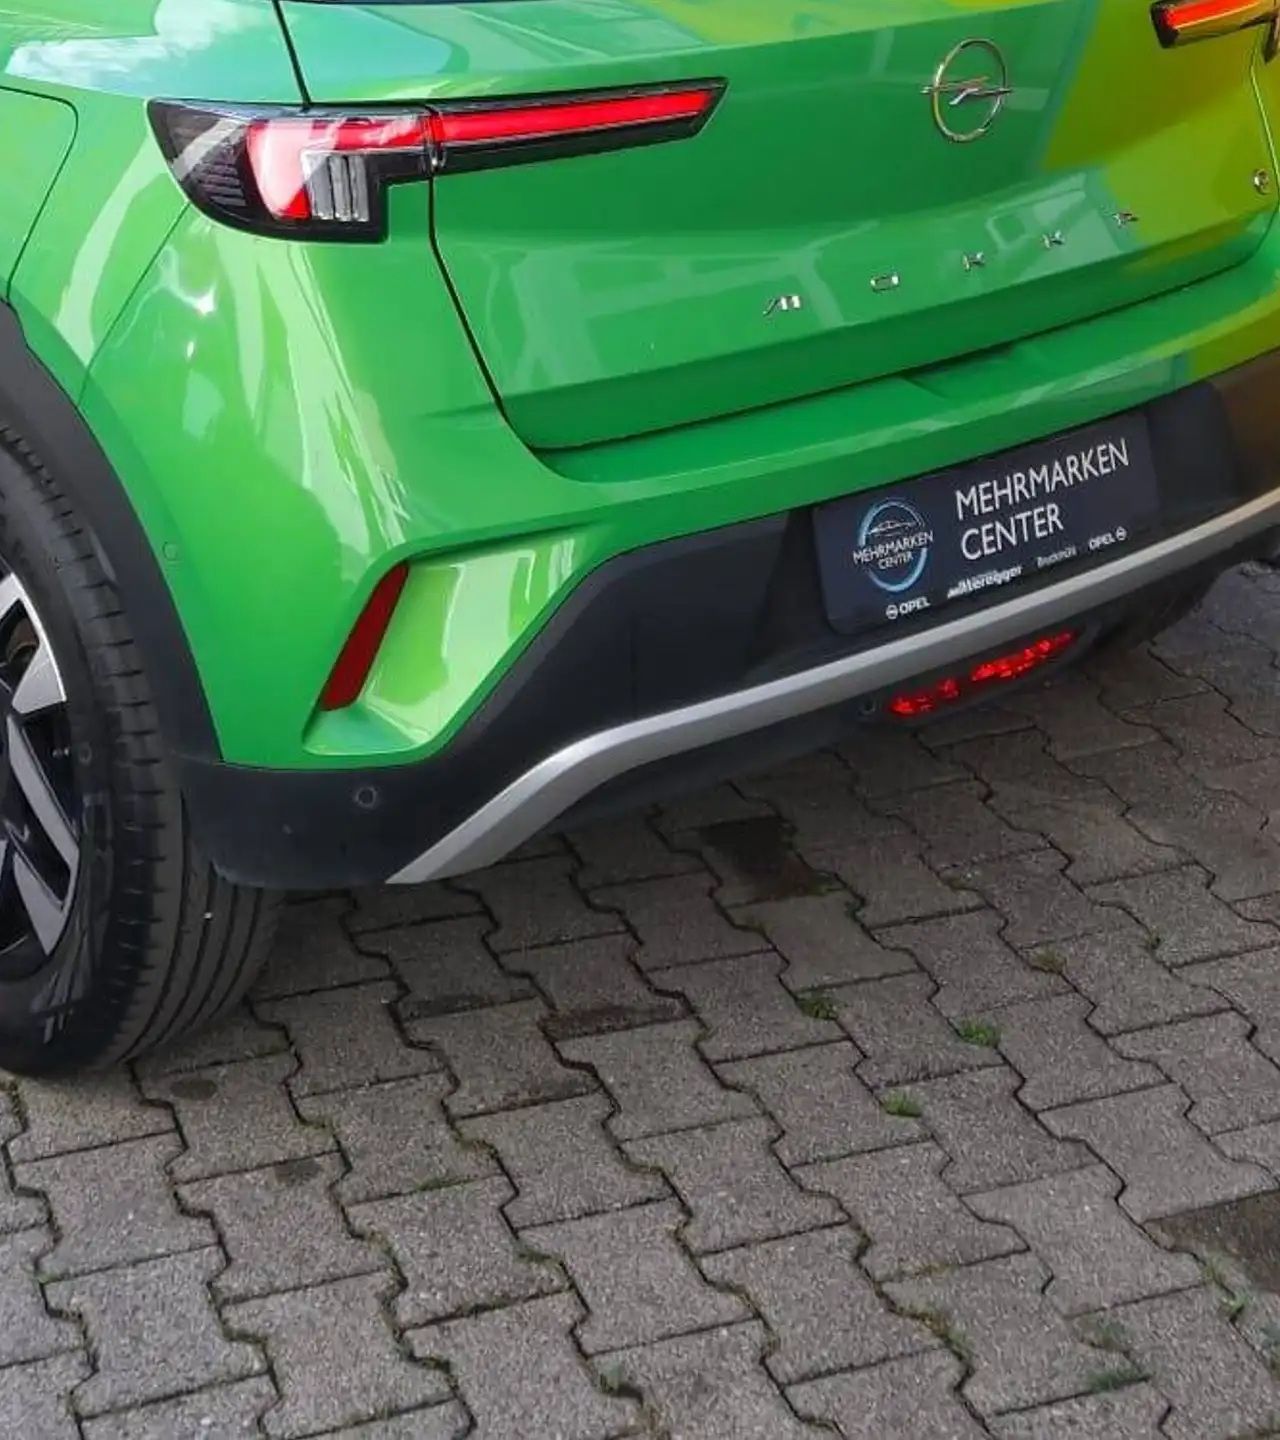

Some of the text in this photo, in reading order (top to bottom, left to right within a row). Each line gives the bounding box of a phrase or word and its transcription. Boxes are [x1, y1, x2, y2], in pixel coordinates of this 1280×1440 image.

[955, 437, 1129, 521] MEHRMARKEN
[853, 529, 934, 564] MEHRMARKEN
[961, 503, 1064, 560] CENTER
[900, 596, 931, 615] OPEL
